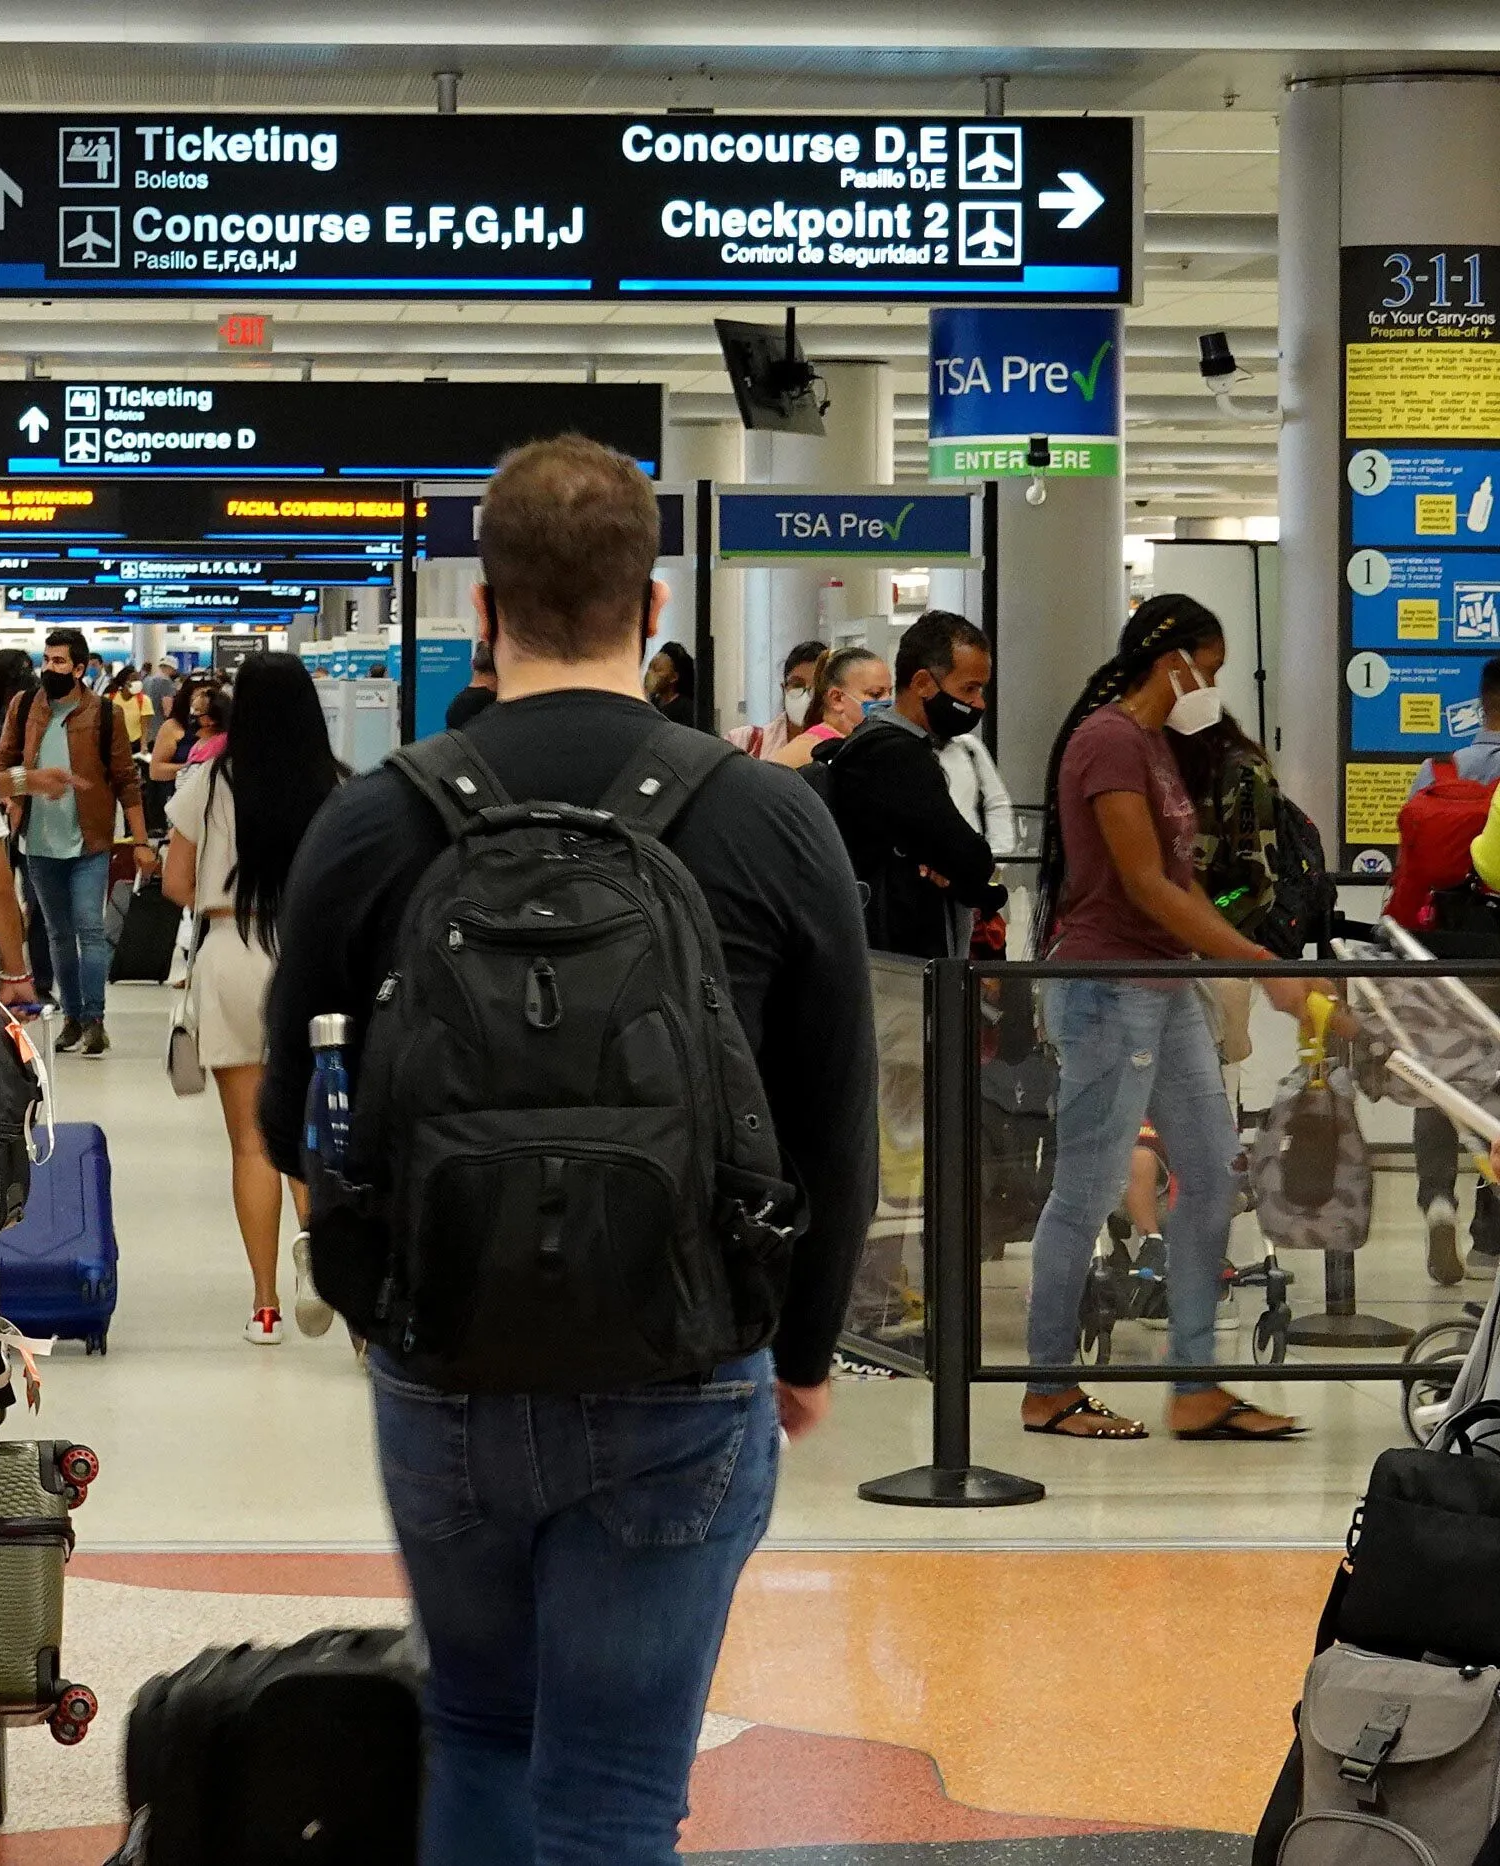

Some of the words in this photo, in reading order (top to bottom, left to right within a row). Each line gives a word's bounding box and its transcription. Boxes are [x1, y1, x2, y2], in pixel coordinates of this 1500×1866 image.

[135, 125, 339, 173] Ticketing
[621, 124, 861, 164] Concourse
[874, 126, 949, 169] D,E
[134, 170, 209, 190] Boletos
[840, 168, 906, 189] Pasillo
[909, 169, 947, 191] D,E
[132, 205, 371, 244] Concourse
[385, 206, 585, 252] E,F,G,H,J
[660, 199, 912, 244] Checkpoint
[923, 201, 949, 239] 2
[133, 250, 198, 270] Pasillo
[203, 250, 298, 272] E,F,G,H,J
[720, 243, 794, 264] Control
[797, 243, 825, 264] de
[828, 243, 930, 267] Seguridad
[933, 244, 949, 265] 2
[1381, 252, 1486, 308] 3-1-1
[227, 316, 266, 346] EXIT
[1368, 310, 1388, 325] for
[1389, 311, 1423, 325] Your
[1426, 310, 1497, 327] Carry-ons
[935, 357, 992, 396] TSA
[1002, 355, 1069, 394] Pre
[104, 385, 213, 412] Ticketing
[104, 427, 232, 450] Concourse
[237, 428, 256, 450] D
[141, 451, 152, 464] D
[954, 451, 1024, 471] ENTER
[1040, 449, 1092, 470] ERE
[1363, 456, 1377, 489] 3
[12, 490, 94, 505] DISTANCING
[227, 500, 279, 517] FACIAL
[280, 500, 354, 517] COVERING
[11, 506, 56, 521] APART
[775, 512, 832, 538] TSA
[840, 512, 883, 538] Pre
[1363, 557, 1373, 585] 1
[1363, 660, 1374, 688] 1
